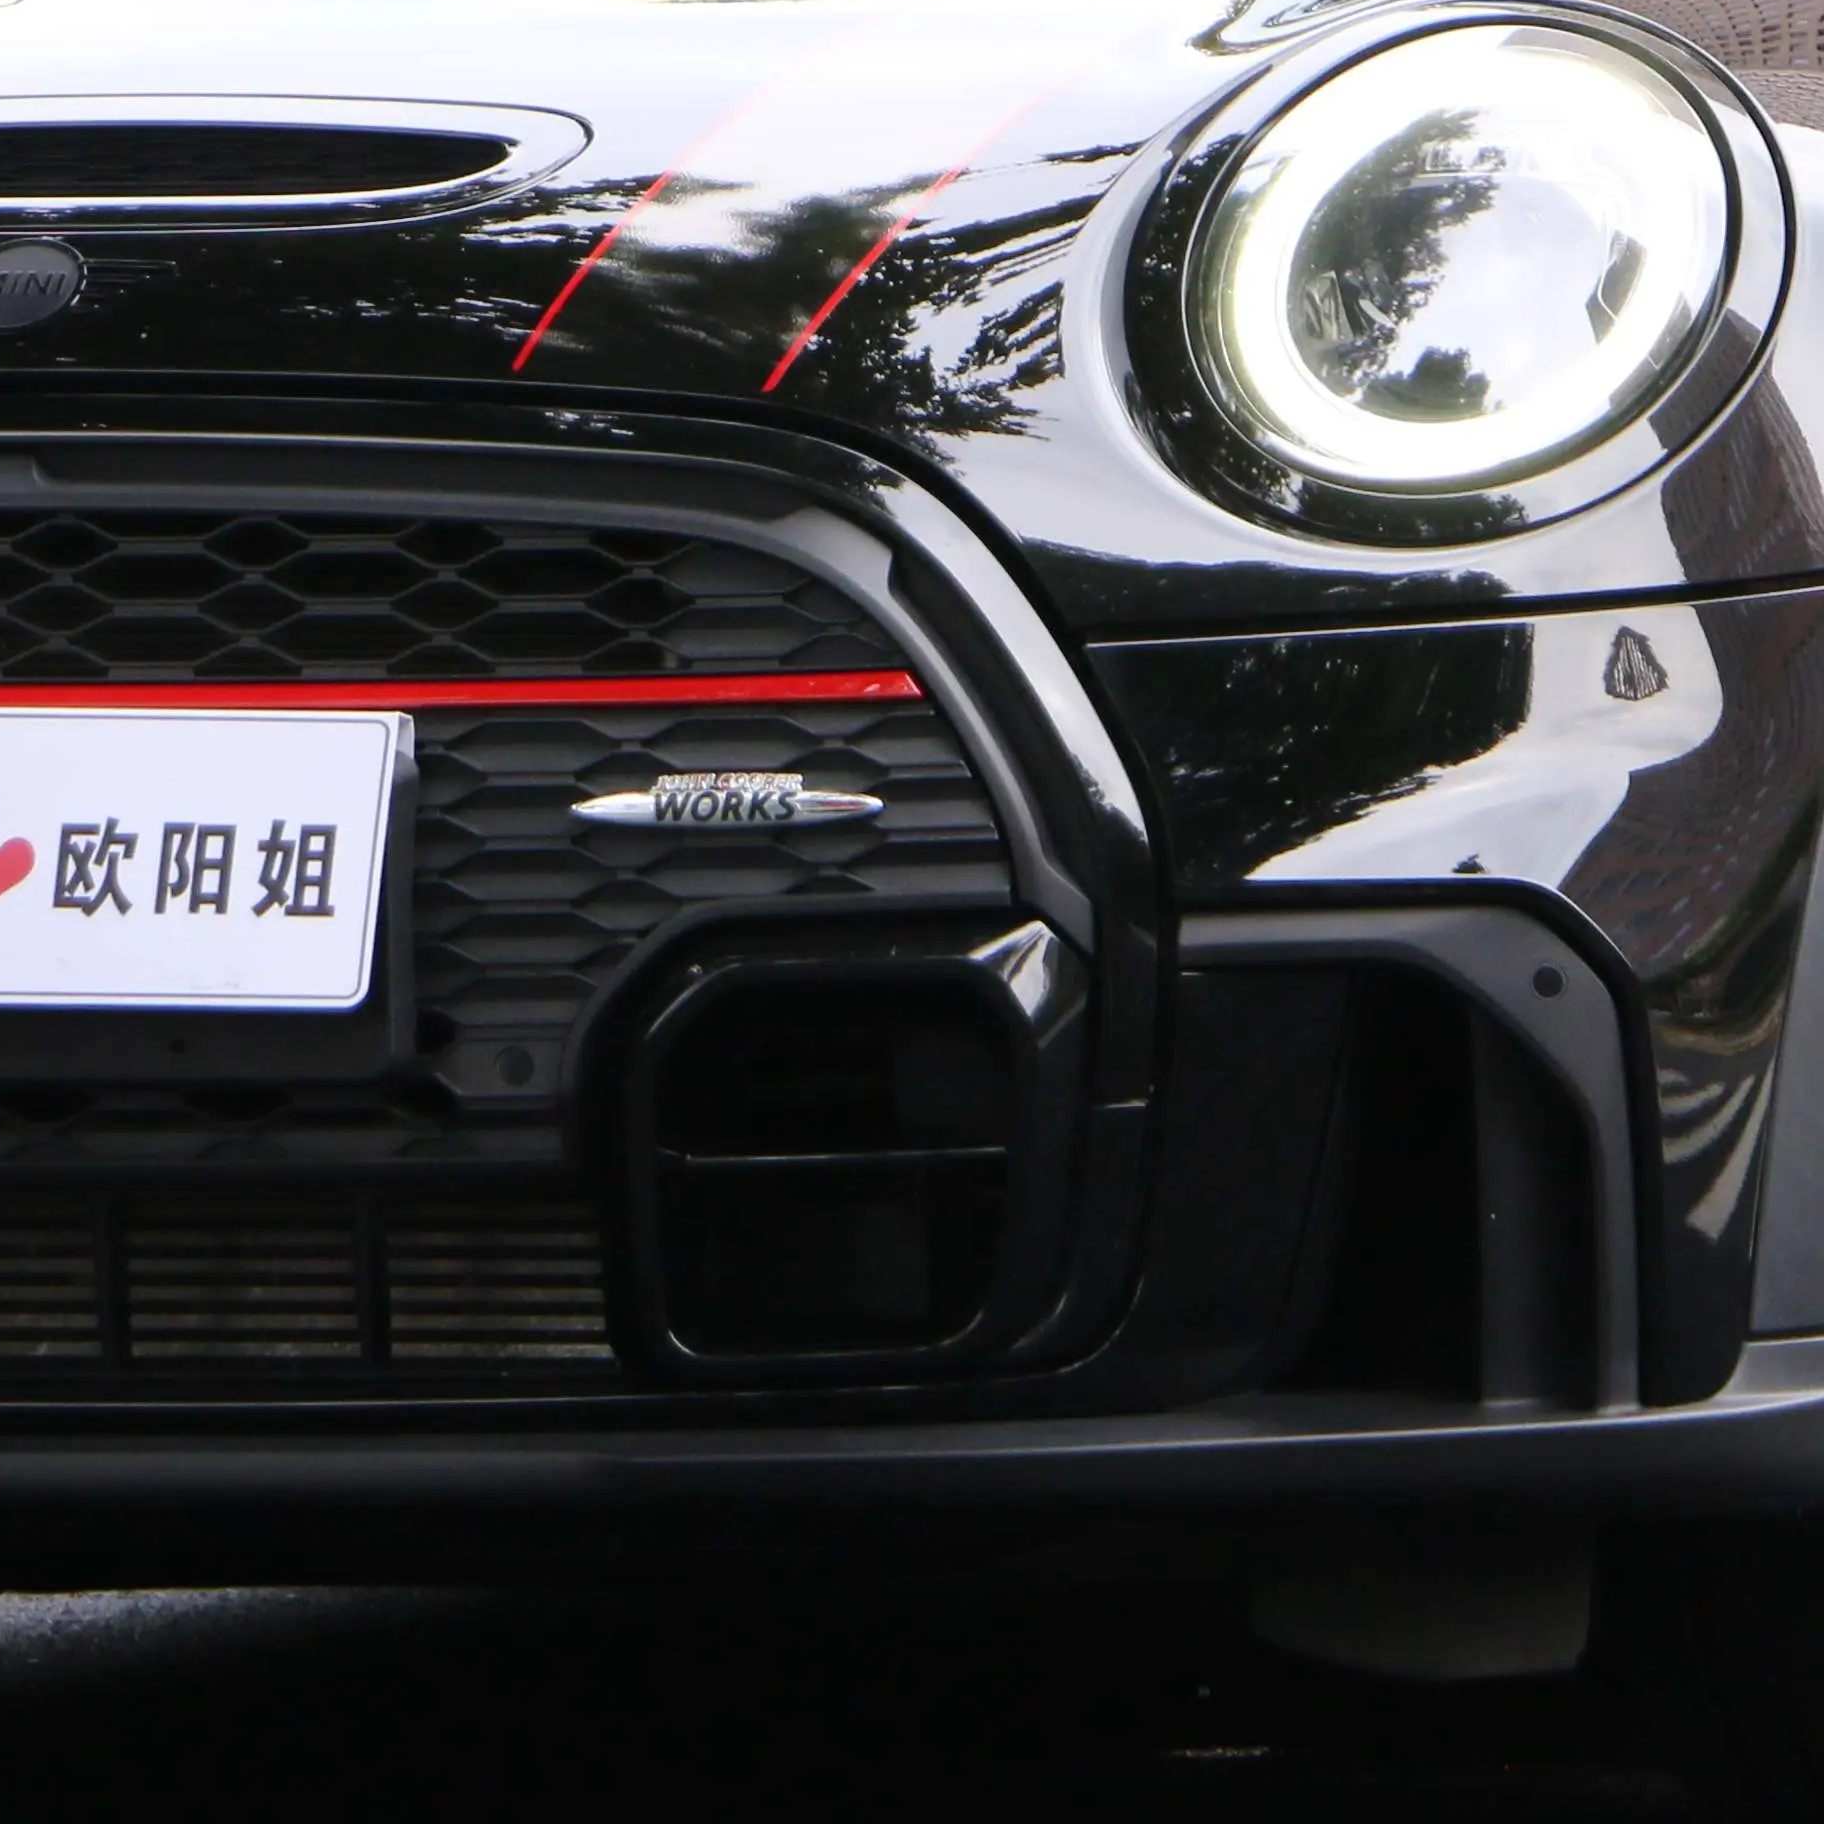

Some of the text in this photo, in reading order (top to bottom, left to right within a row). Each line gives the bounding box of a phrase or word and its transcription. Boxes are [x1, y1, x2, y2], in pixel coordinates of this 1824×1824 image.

[654, 790, 798, 822] WORKS
[52, 816, 338, 917] 欧阳姐
